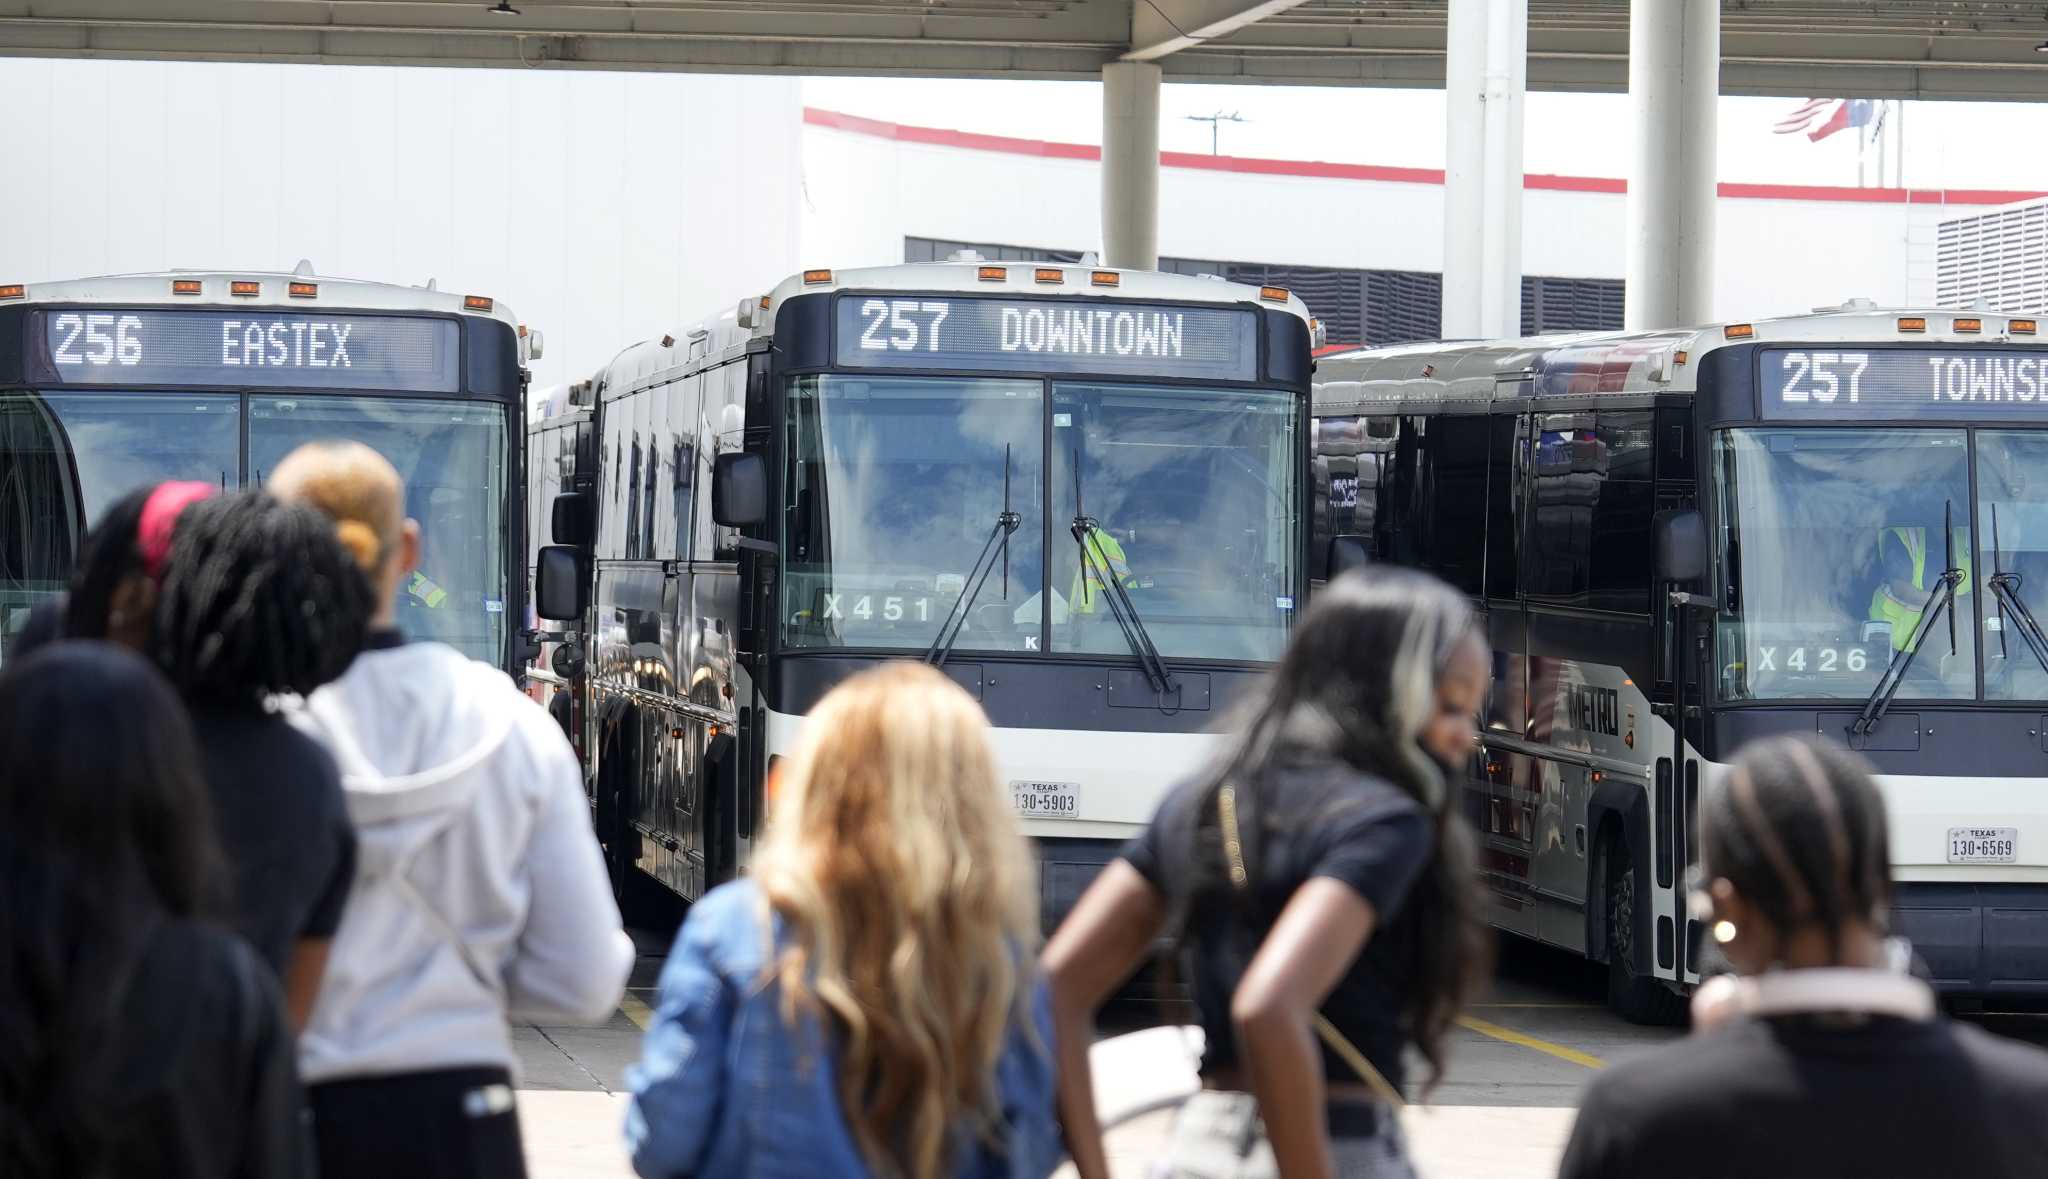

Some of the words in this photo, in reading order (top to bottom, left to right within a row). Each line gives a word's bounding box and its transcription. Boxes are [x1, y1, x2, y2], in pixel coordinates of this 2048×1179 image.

[55, 314, 142, 365] 256
[222, 320, 351, 367] EASTEX
[861, 300, 948, 351] 257
[1001, 307, 1183, 356] DOWNTOWN
[1783, 352, 1869, 402] 257
[1025, 636, 1038, 649] K
[1568, 683, 1619, 736] METRO
[1032, 783, 1058, 791] TEXAS
[1970, 829, 1996, 837] TEXAS
